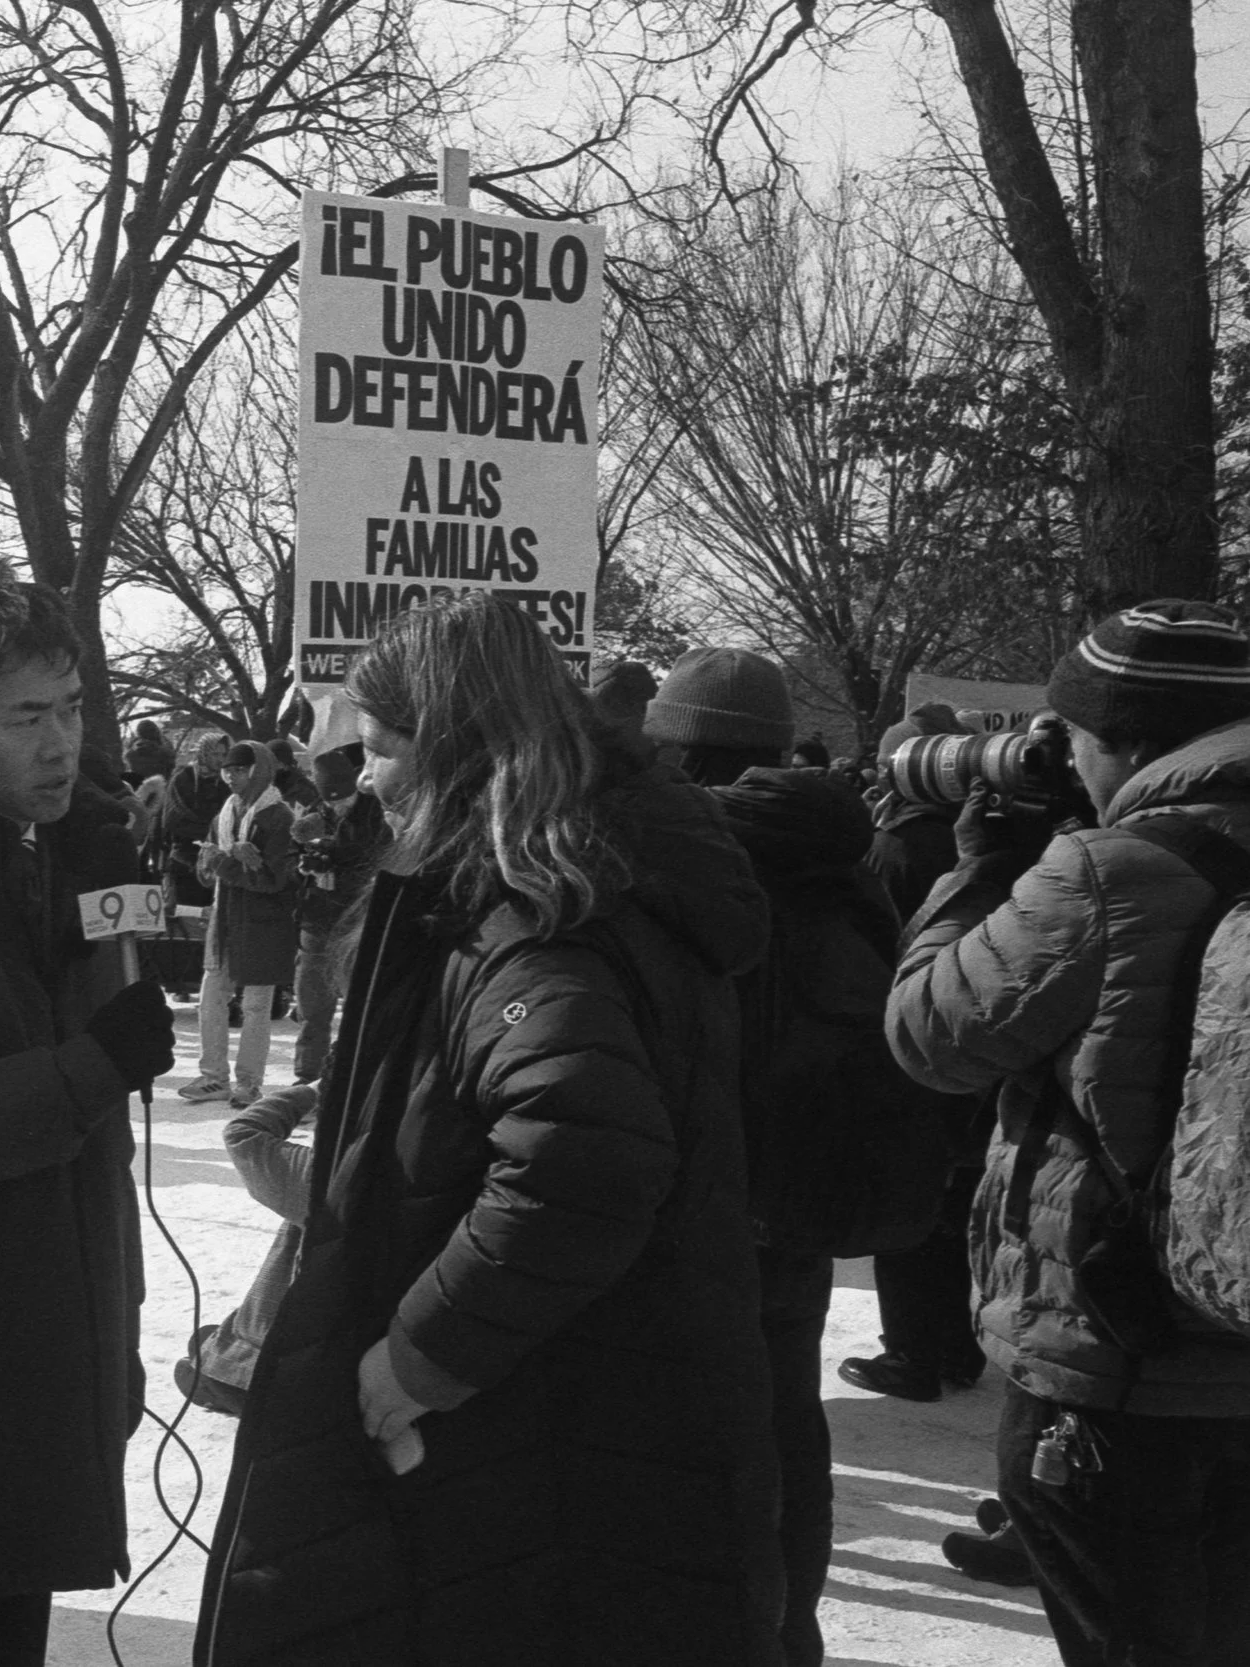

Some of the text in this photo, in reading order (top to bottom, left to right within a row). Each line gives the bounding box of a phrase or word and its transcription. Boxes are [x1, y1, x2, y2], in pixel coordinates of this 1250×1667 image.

[320, 204, 589, 304] ¡EL PUEBLO
[382, 284, 527, 369] UNIDO
[314, 351, 589, 445] DEFENDERÁ
[400, 455, 502, 519] A LAS
[365, 517, 539, 583] FAMILIAS
[309, 580, 587, 647] INMIES!
[99, 891, 125, 930] 9
[146, 888, 162, 926] 9
